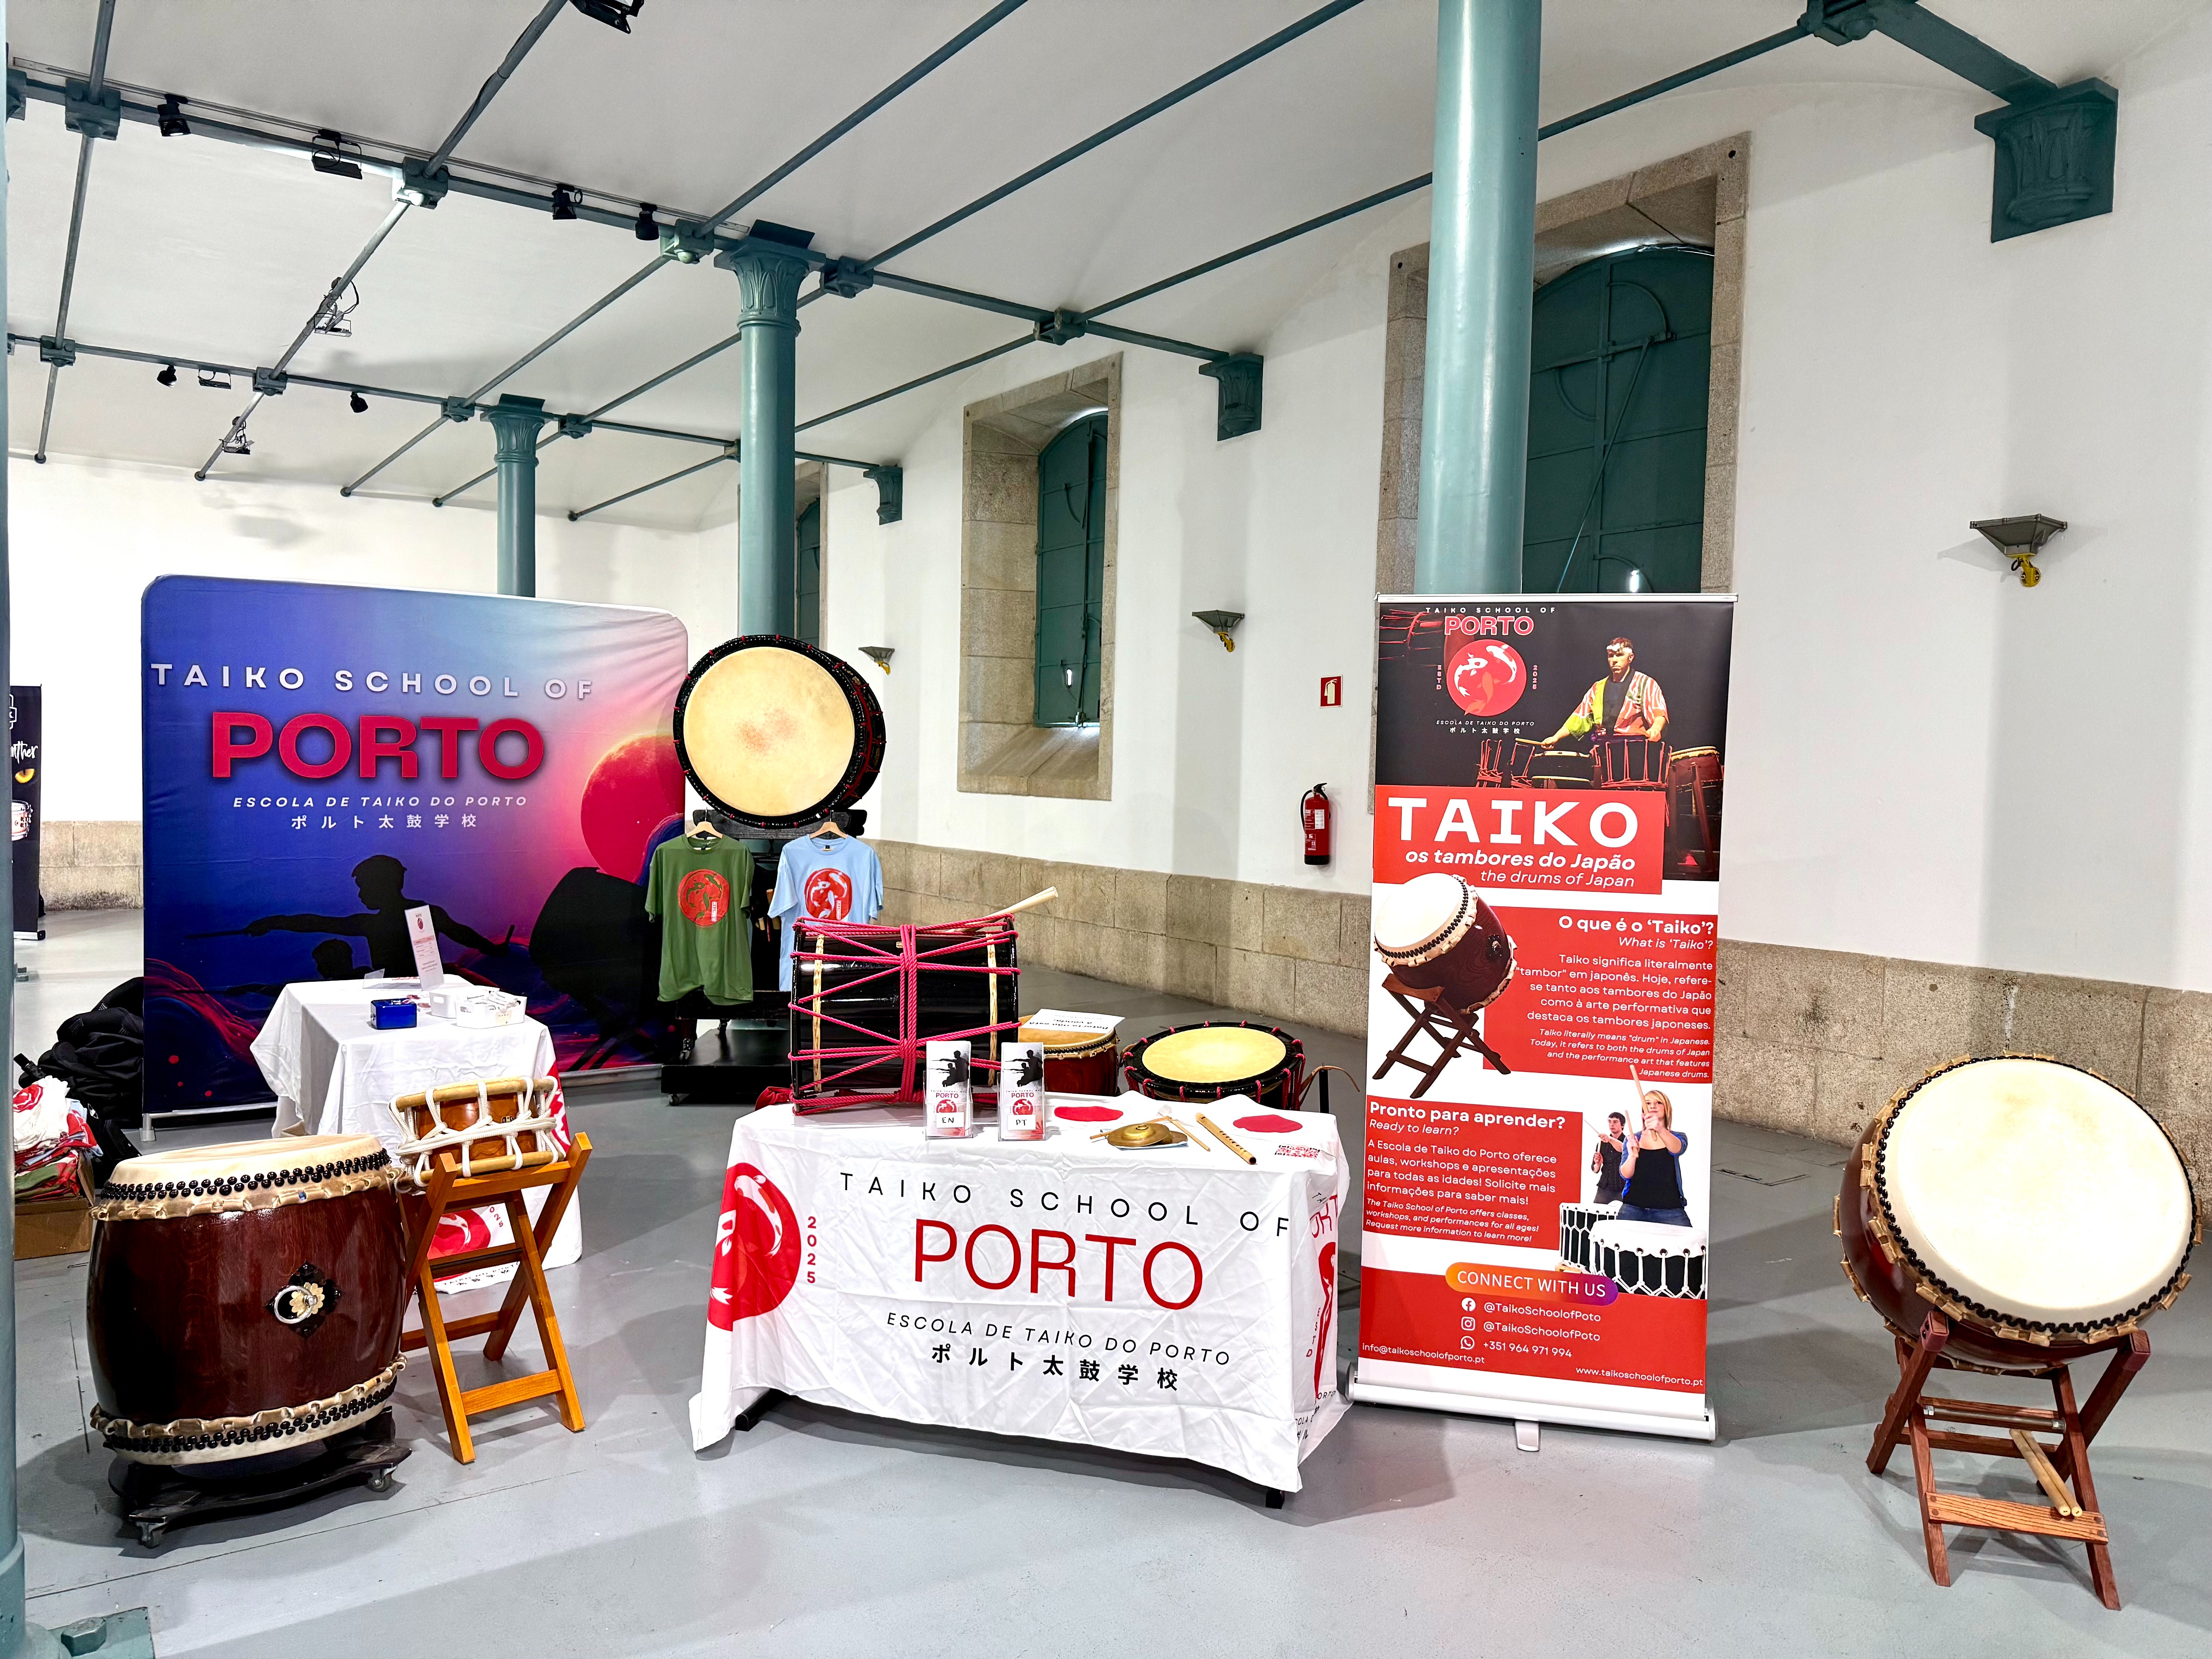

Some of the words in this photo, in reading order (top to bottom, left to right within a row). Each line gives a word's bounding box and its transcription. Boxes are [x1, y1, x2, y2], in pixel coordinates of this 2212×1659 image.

[1444, 616, 1534, 635] PORTO
[150, 663, 304, 690] TAIKO
[334, 670, 519, 697] SCHOOL
[544, 679, 594, 699] OF
[10, 740, 38, 764] nther
[212, 711, 545, 779] PORTO
[233, 797, 314, 808] ESCOLA
[325, 796, 350, 807] DE
[360, 796, 420, 807] TAIKO
[429, 796, 455, 807] DO
[465, 796, 527, 807] PORTO
[291, 813, 477, 830] ポルト太鼓学校
[1388, 797, 1638, 848] TAIKO
[1405, 850, 1429, 863] os
[1433, 849, 1534, 867] tambores
[1538, 851, 1566, 868] do
[1570, 853, 1636, 872] Japão
[1480, 869, 1506, 882] the
[1510, 870, 1562, 884] drums
[1565, 872, 1585, 885] of
[1585, 871, 1635, 889] Japan
[1558, 915, 1573, 929] O
[1577, 919, 1612, 933] que
[1615, 917, 1627, 932] é
[1631, 921, 1643, 933] o
[1619, 936, 1653, 948] What
[1655, 938, 1666, 948] is
[1558, 954, 1590, 965] Taiko
[1592, 956, 1642, 968] significa
[1644, 958, 1713, 970] literalmente
[1515, 966, 1567, 978] "tambor"
[1569, 971, 1588, 979] em
[1589, 970, 1640, 982] japonês.
[1642, 973, 1671, 985] Hoje,
[1674, 975, 1712, 985] refere-
[1530, 983, 1543, 991] se
[1545, 983, 1577, 993] tanto
[1579, 986, 1600, 995] aos
[1602, 986, 1660, 998] tambores
[1662, 989, 1678, 999] do
[1680, 990, 1712, 1002] Japão
[1540, 998, 1573, 1008] como
[1575, 999, 1583, 1008] à
[1585, 1001, 1610, 1010] arte
[1612, 1002, 1689, 1015] performativa
[1691, 1007, 1712, 1016] que
[1527, 1010, 1573, 1022] destaca
[1575, 1015, 1590, 1023] os
[1592, 1015, 1649, 1027] tambores
[1650, 1018, 1711, 1030] japoneses.
[1539, 1028, 1562, 1037] Taiko
[1563, 1029, 1596, 1041] literally
[1597, 1033, 1627, 1041] means
[1669, 1037, 1710, 1046] Japanese.
[1565, 1051, 1580, 1060] the
[1581, 1053, 1640, 1064] performance
[1656, 1058, 1674, 1066] that
[1676, 1059, 1710, 1067] features
[1638, 1068, 1681, 1077] Japanese
[1681, 1070, 1709, 1078] drums.
[1370, 1101, 1426, 1119] Pronto
[1430, 1109, 1469, 1122] para
[1474, 1113, 1566, 1130] aprender?
[1369, 1118, 1405, 1133] Ready
[1407, 1123, 1420, 1133] to
[1422, 1123, 1460, 1136] learn?
[1367, 1139, 1375, 1148] A
[1377, 1140, 1411, 1152] Escola
[1413, 1144, 1428, 1154] de
[1430, 1145, 1460, 1156] Taiko
[1462, 1147, 1477, 1157] do
[1479, 1149, 1510, 1160] Porto
[1512, 1151, 1557, 1164] oferece
[1367, 1154, 1398, 1166] aulas,
[1400, 1158, 1460, 1171] workshops
[1472, 1164, 1556, 1179] apresentações
[1367, 1169, 1391, 1178] para
[1393, 1171, 1425, 1182] todas
[1427, 1175, 1440, 1183] as
[1442, 1174, 1482, 1187] idades!
[1484, 1178, 1527, 1190] Solicite
[1529, 1183, 1556, 1193] mais
[1367, 1180, 1434, 1198] informações
[1437, 1190, 1462, 1200] para
[1464, 1192, 1497, 1202] saber
[1499, 1195, 1528, 1205] mais!
[839, 1171, 972, 1204] TAIKO
[1009, 1188, 1199, 1226] SCHOOL
[1239, 1211, 1290, 1237] OF
[1367, 1197, 1381, 1207] The
[1382, 1200, 1404, 1209] Taiko
[1405, 1203, 1434, 1212] School
[1445, 1206, 1468, 1215] Porto
[1469, 1208, 1495, 1218] offers
[1496, 1211, 1529, 1221] classes,
[489, 1206, 503, 1227] 025
[1366, 1210, 1411, 1221] workshops,
[1429, 1216, 1489, 1228] performances
[1491, 1220, 1504, 1229] for
[1516, 1224, 1539, 1233] ages!
[1365, 1219, 1399, 1230] Request
[1423, 1225, 1472, 1237] information
[1484, 1231, 1506, 1240] learn
[806, 1215, 817, 1284] 2025
[914, 1218, 1204, 1311] PORTO
[1457, 1270, 1534, 1290] CONNECT
[1537, 1278, 1579, 1295] WITH
[1585, 1282, 1606, 1297] US
[1484, 1302, 1601, 1322] @TaikoSchoolofPoto
[886, 1311, 972, 1336] ESCOLA
[985, 1323, 1013, 1340] DE
[1025, 1327, 1092, 1348] TAIKO
[1104, 1337, 1137, 1354] DO
[1149, 1341, 1230, 1366] PORTO
[1483, 1321, 1601, 1341] @TaikoSchoolofPoto
[1362, 1342, 1485, 1364] info@taikoschoolofporto.pt
[1483, 1341, 1506, 1351] +351
[1508, 1343, 1529, 1353] 964
[1532, 1345, 1549, 1355] 971
[1551, 1347, 1572, 1358] 994
[931, 1343, 1178, 1392] ポルト太鼓学校
[1575, 1367, 1704, 1387] www.taikoschoolofporto.pt
